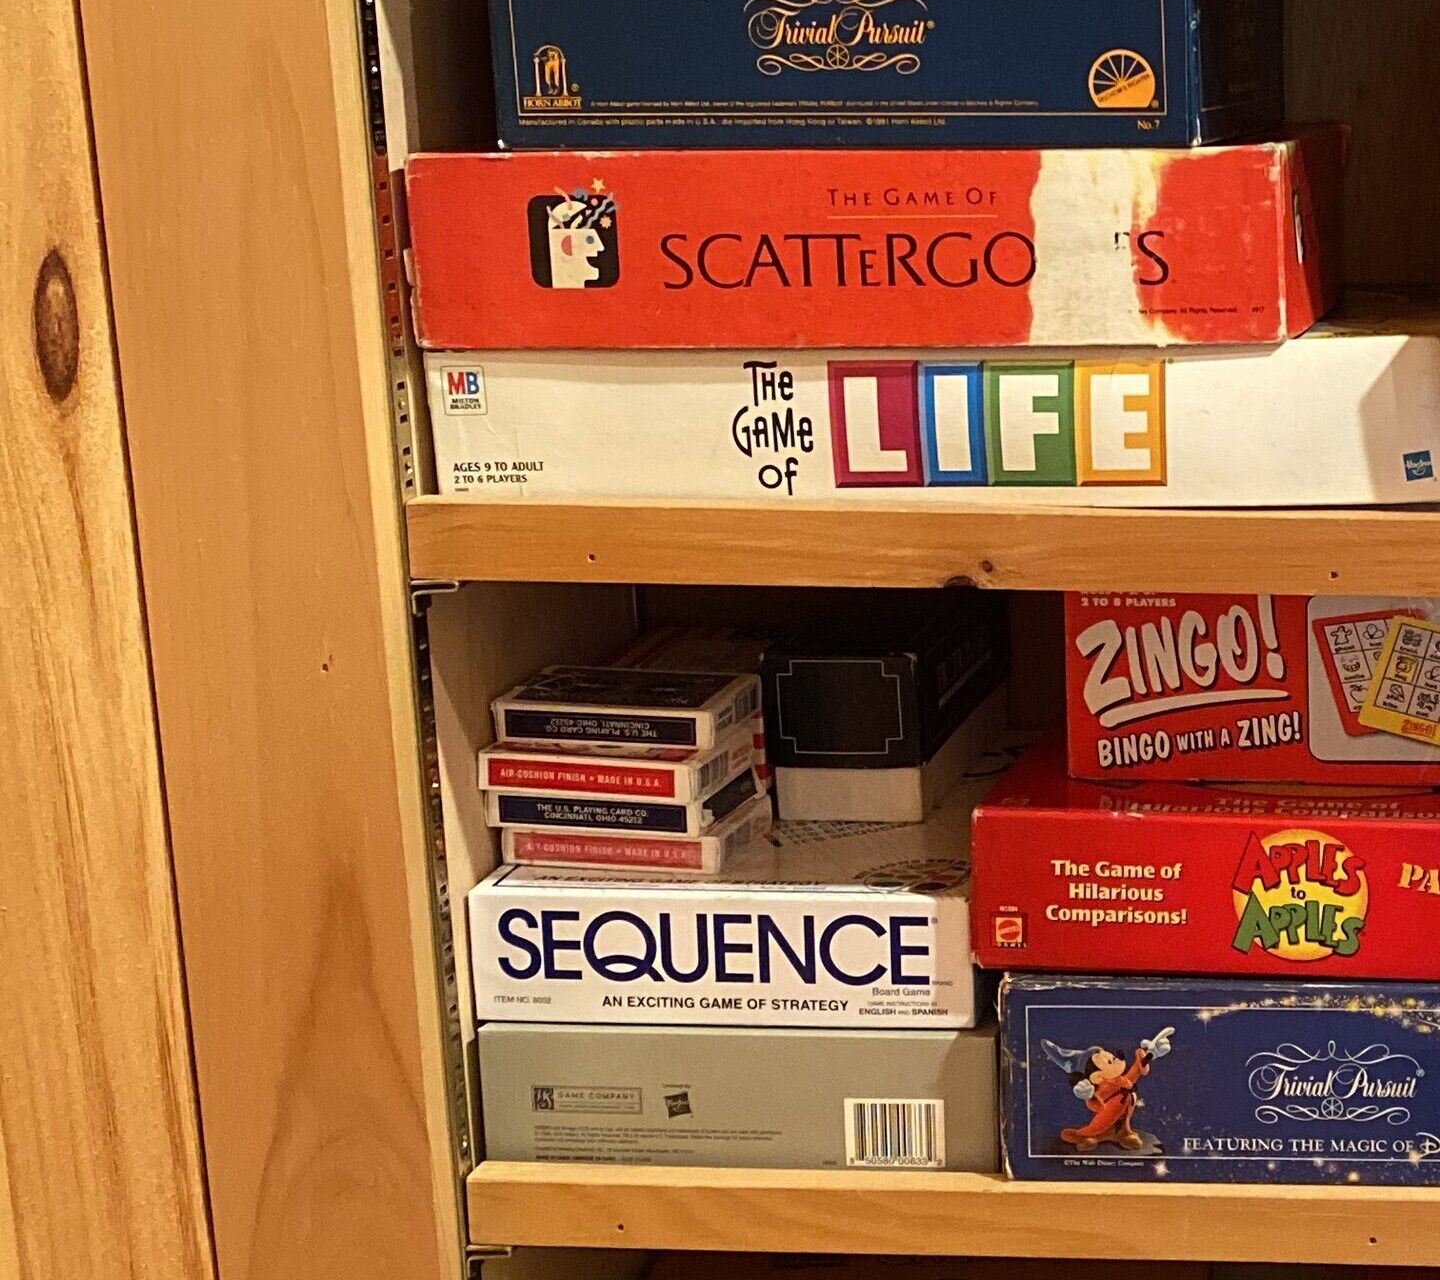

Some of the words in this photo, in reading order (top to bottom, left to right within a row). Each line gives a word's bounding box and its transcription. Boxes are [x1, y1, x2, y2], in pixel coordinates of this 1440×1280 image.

[748, 9, 840, 48] Trivial
[836, 6, 927, 47] Pursuit
[827, 188, 872, 206] THE
[884, 187, 955, 206] GAME
[966, 187, 997, 205] OF
[660, 231, 1170, 290] SCATTERGOS
[447, 371, 481, 395] MB
[843, 372, 1152, 473] LIFE
[453, 462, 481, 472] AGES
[511, 461, 544, 472] ADULT
[486, 474, 528, 484] PLAYERS
[1125, 598, 1176, 607] PLAYERS
[1076, 594, 1284, 715] ZINGO!
[1098, 733, 1170, 767] BINGO
[1177, 729, 1213, 751] WITH
[1220, 728, 1230, 746] A
[1237, 711, 1300, 747] ZING!
[1051, 859, 1091, 880] The
[1094, 860, 1154, 880] Game
[1157, 861, 1183, 881] of
[1231, 830, 1365, 895] APPLES
[1068, 880, 1164, 903] Hilarious
[1290, 884, 1307, 901] to
[1045, 904, 1187, 927] Comparisons!
[1232, 894, 1366, 956] APPLES
[498, 907, 930, 987] SEQUENCE
[602, 995, 624, 1007] AN
[627, 996, 696, 1009] EXCITING
[699, 997, 743, 1010] GAME
[746, 998, 767, 1010] OF
[770, 999, 849, 1012] STRATEGY
[1183, 1137, 1283, 1154] FEATURING
[1289, 1138, 1324, 1154] THE
[1330, 1138, 1386, 1154] MAGIC
[1391, 1138, 1415, 1154] OF
